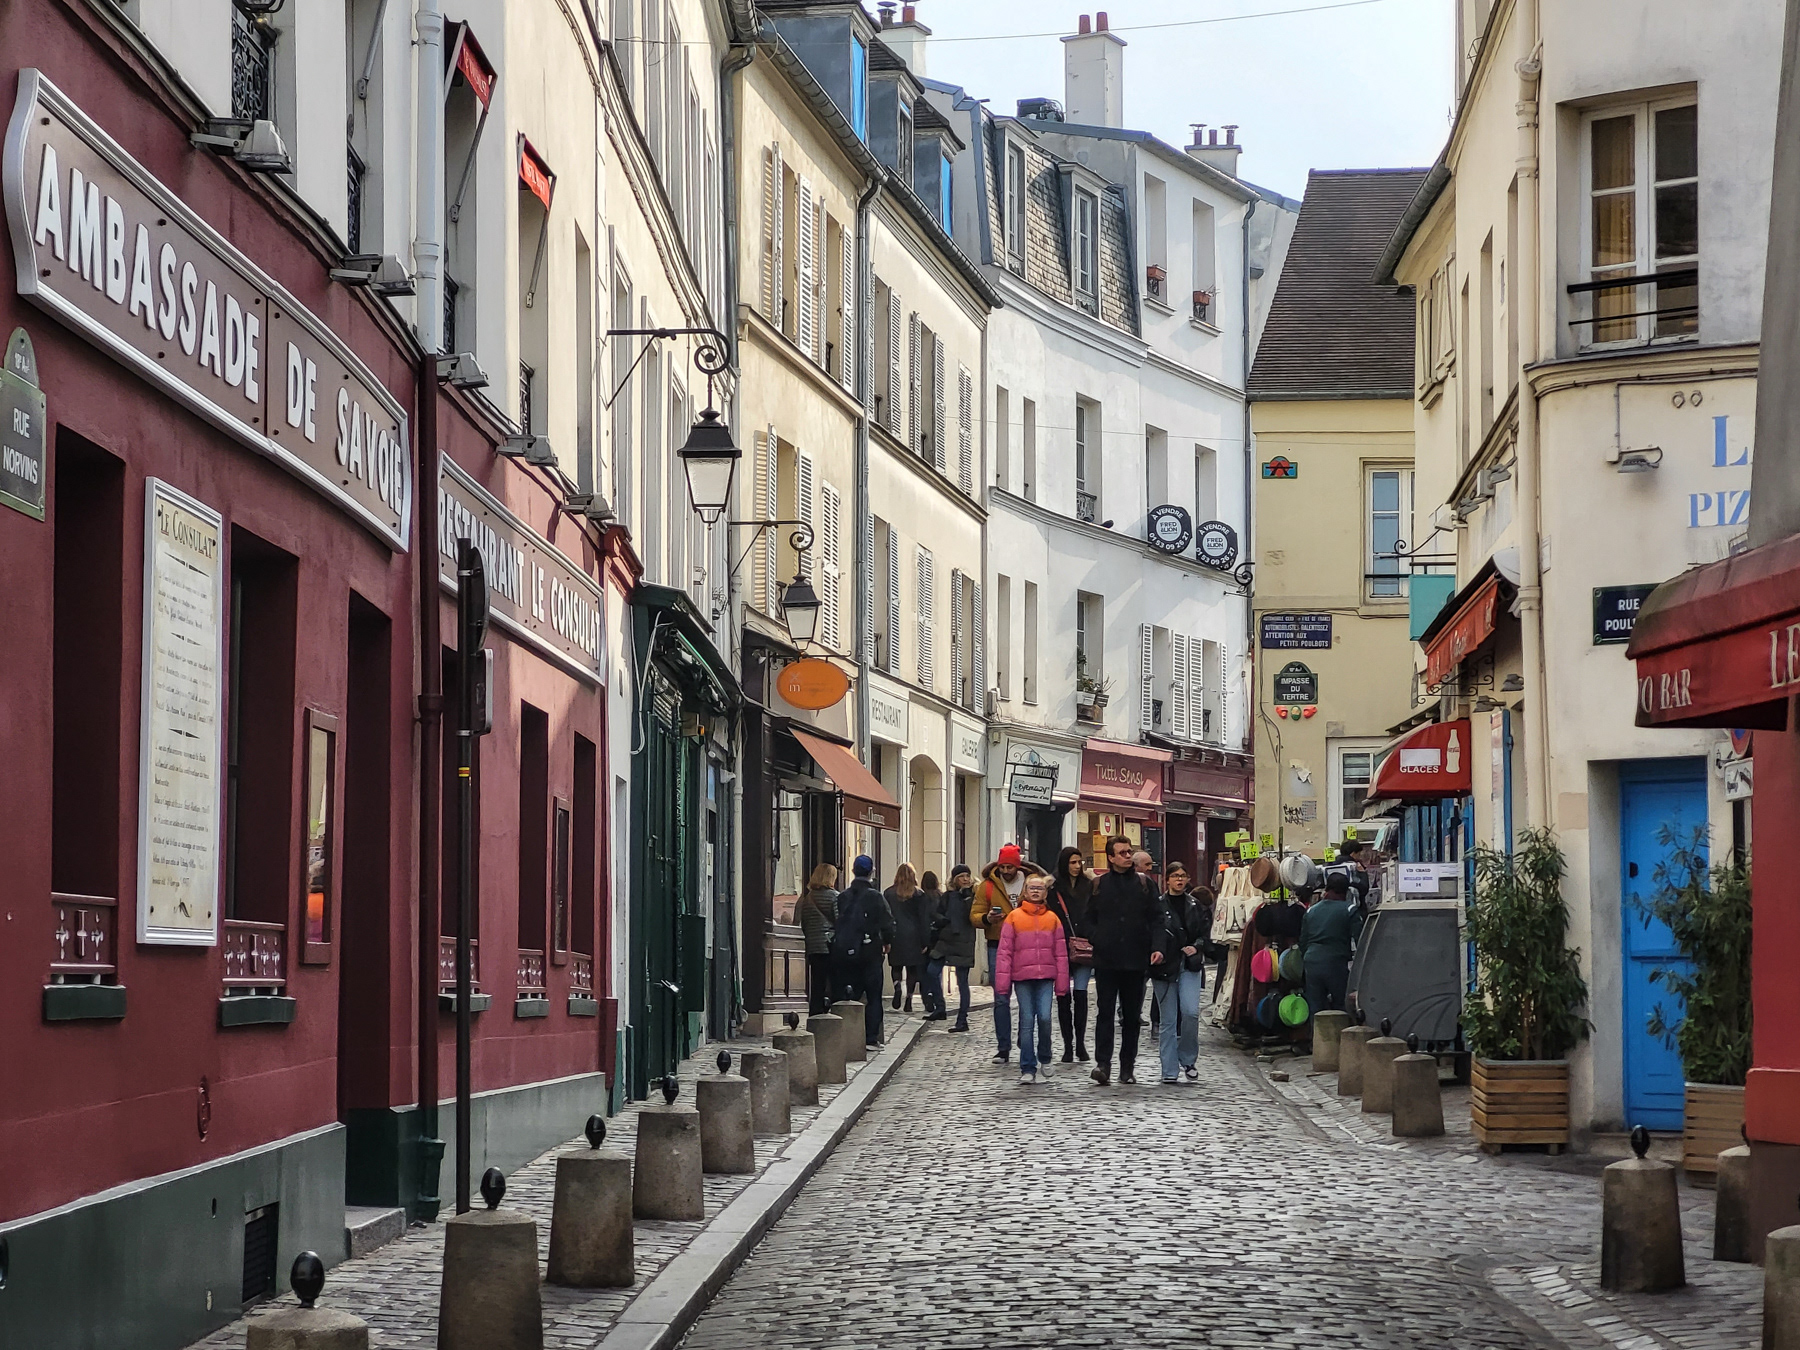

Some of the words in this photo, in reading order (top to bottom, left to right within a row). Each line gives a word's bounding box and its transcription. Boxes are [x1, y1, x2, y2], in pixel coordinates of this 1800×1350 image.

[35, 143, 260, 404] AMBASSADE
[287, 341, 317, 443] DE
[336, 386, 402, 516] SAVOIE
[13, 407, 30, 439] RUE
[3, 445, 38, 485] NORVINS
[1155, 507, 1184, 519] VENDRE
[1203, 523, 1231, 536] VENDRE
[531, 560, 545, 623] LE
[550, 576, 600, 661] CONSULAT
[1618, 598, 1641, 611] RUE
[1280, 677, 1310, 685] IMPASSE
[1659, 668, 1693, 710] BAR
[871, 698, 902, 729] RESTAURANT
[1095, 763, 1117, 782] Tutti
[1119, 767, 1144, 786] Sensi
[1400, 765, 1439, 774] GLACES
